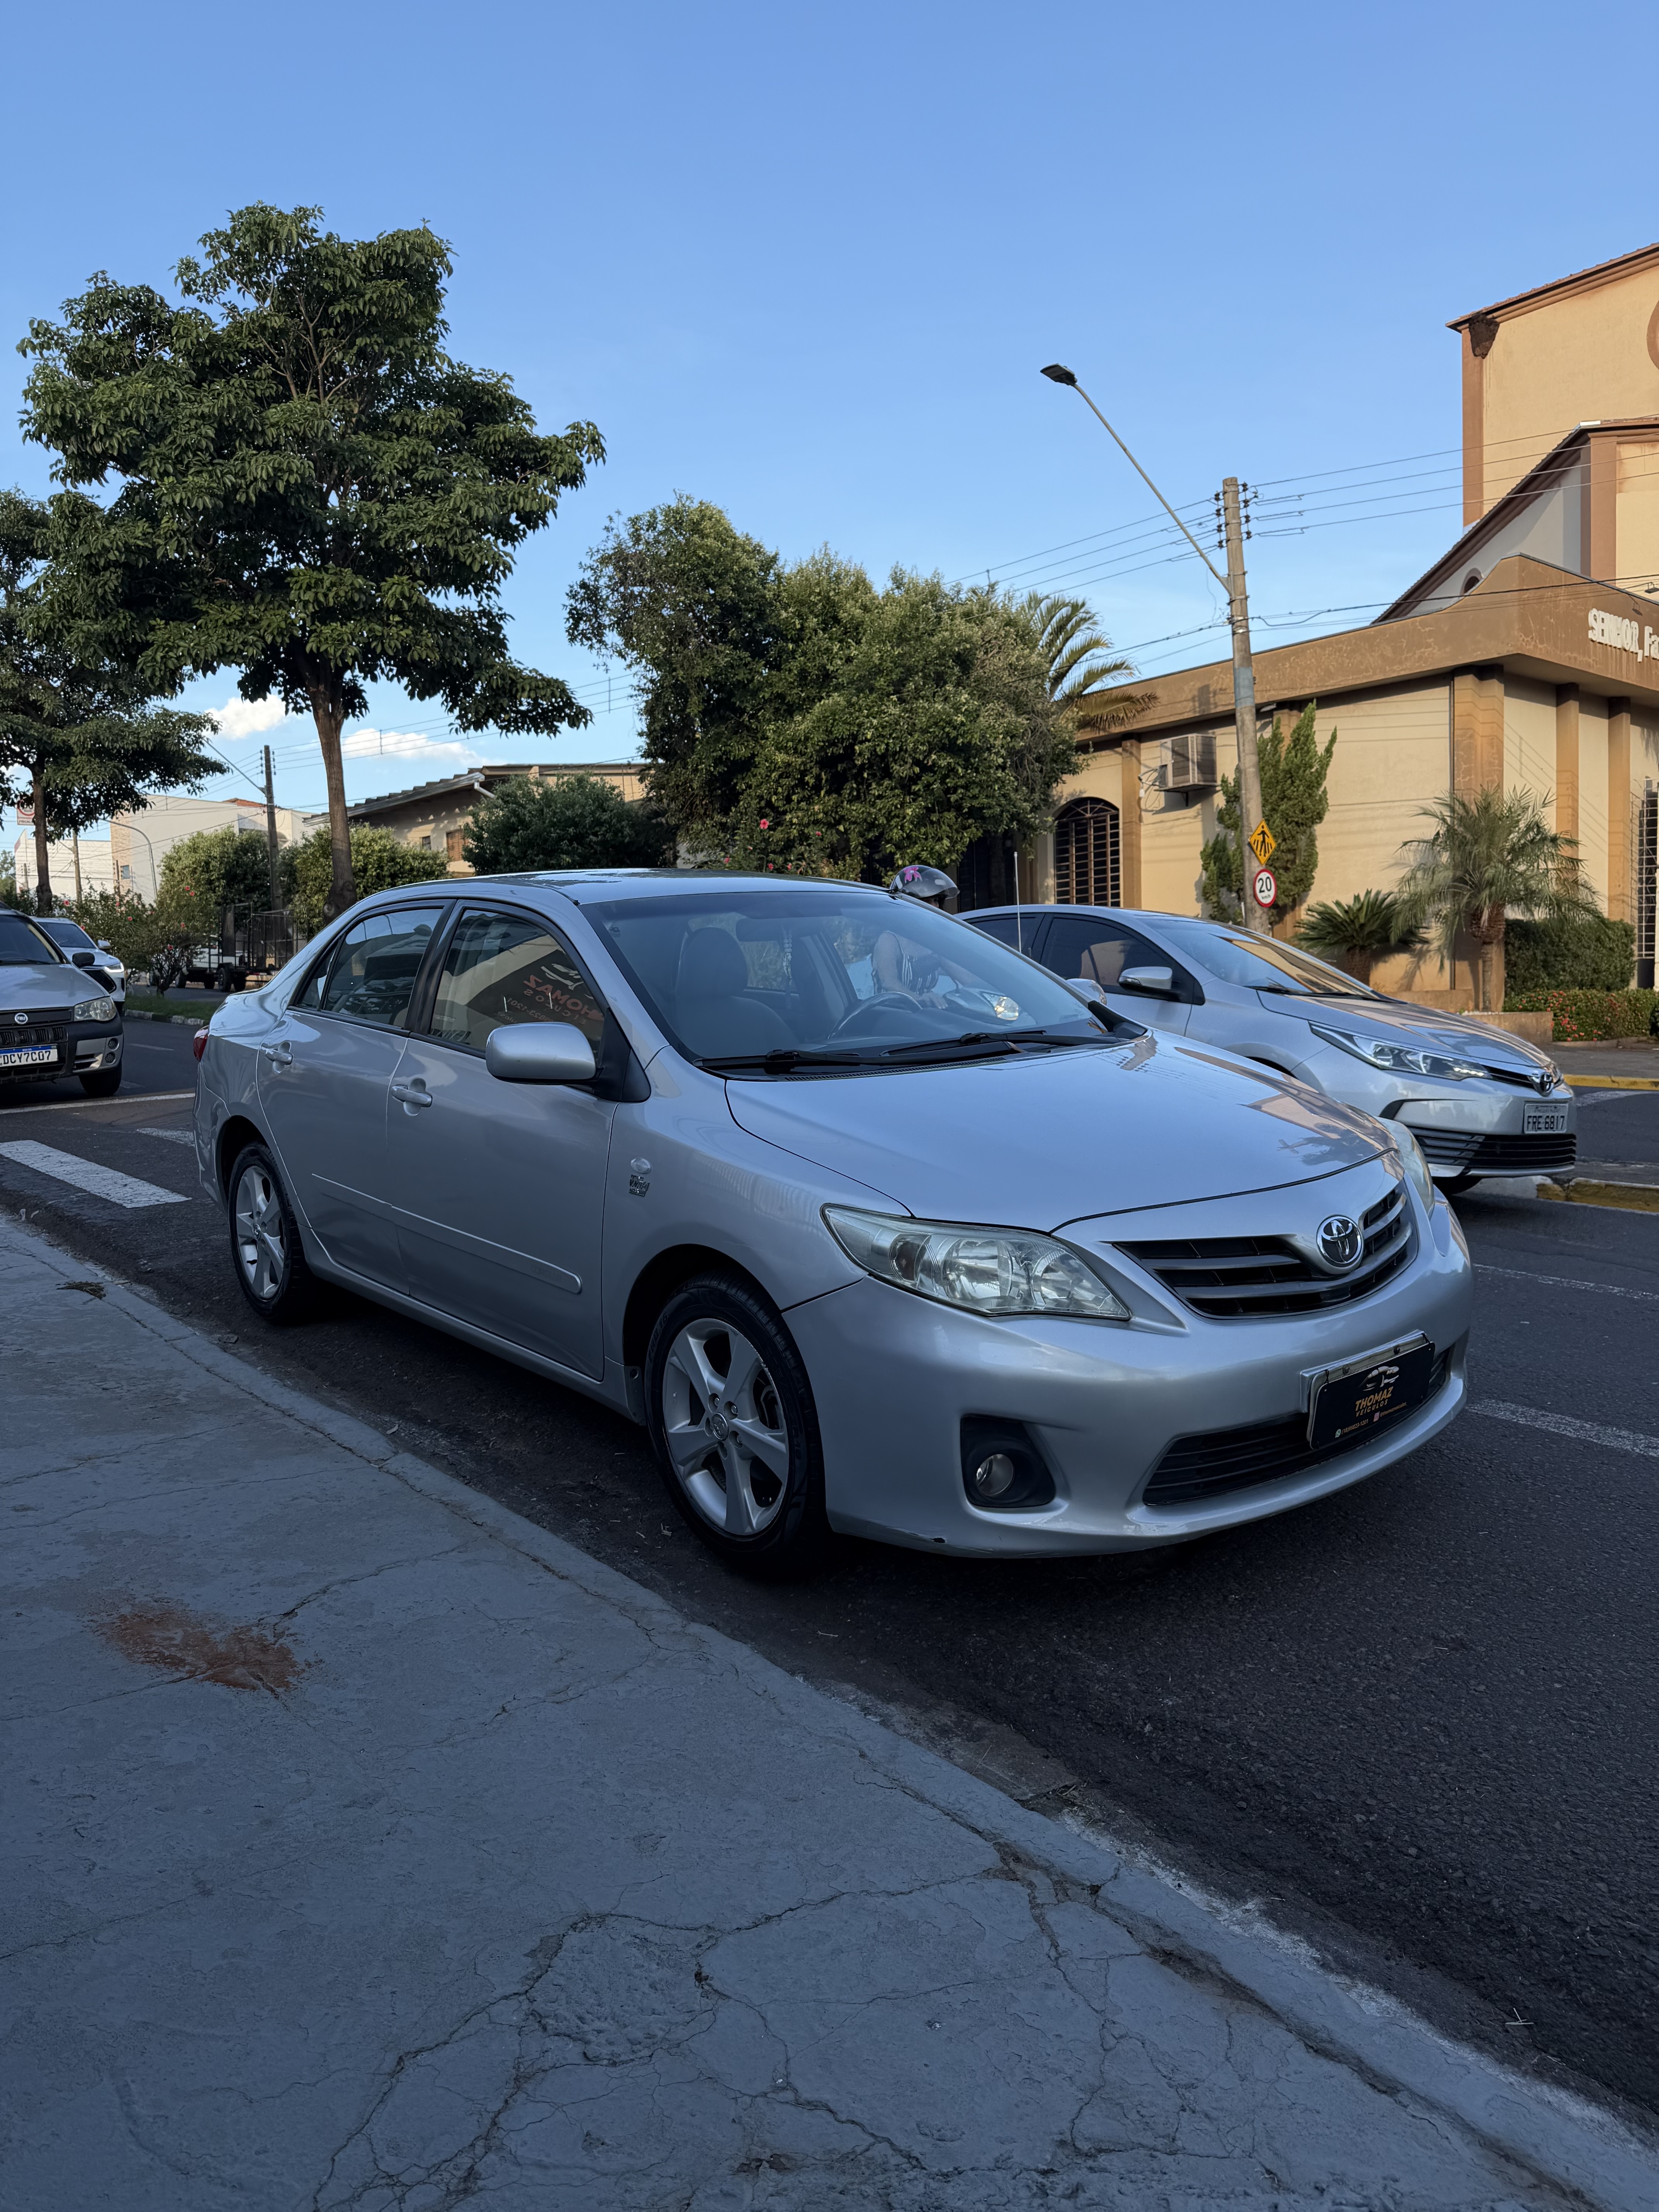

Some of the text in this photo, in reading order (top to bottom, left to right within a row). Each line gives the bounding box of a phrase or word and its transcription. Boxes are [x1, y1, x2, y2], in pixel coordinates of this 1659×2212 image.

[1644, 626, 1659, 660] Fa
[1258, 876, 1272, 893] 20
[3, 1050, 51, 1065] DCY7C07
[1355, 1386, 1394, 1412] THOMAZ
[1356, 1399, 1389, 1417] VEÍCULOS
